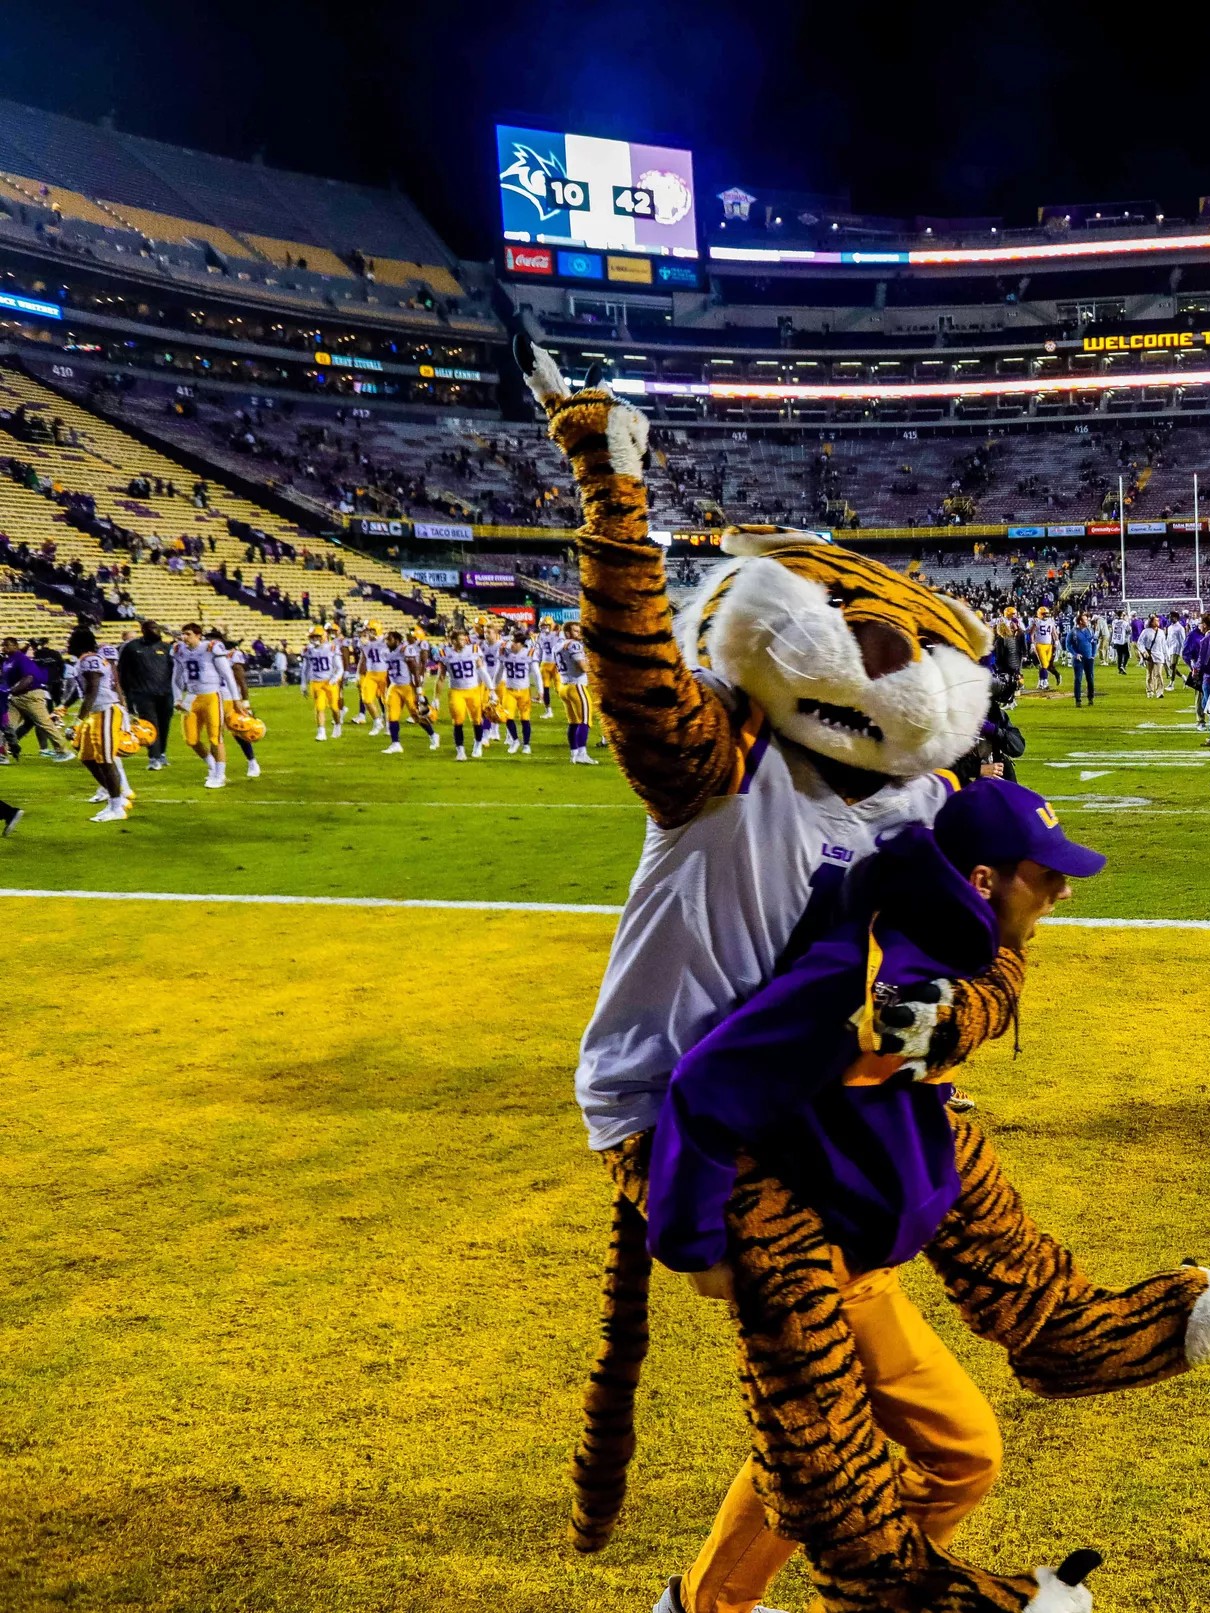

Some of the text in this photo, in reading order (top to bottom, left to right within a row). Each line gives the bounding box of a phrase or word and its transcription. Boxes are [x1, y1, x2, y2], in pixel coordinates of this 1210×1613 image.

[551, 181, 584, 206] 10
[615, 191, 652, 215] 42
[1083, 332, 1194, 351] WELCOME
[52, 365, 74, 378] 410
[731, 431, 748, 441] 414
[902, 431, 918, 440] 415
[431, 527, 470, 539] TACO BELL
[428, 572, 447, 583] POWER
[1040, 625, 1051, 636] 54
[367, 648, 381, 662] 41
[186, 660, 200, 680] 8
[311, 656, 330, 672] 30
[450, 660, 474, 679] 89
[504, 661, 526, 679] 85
[822, 843, 854, 863] LSU
